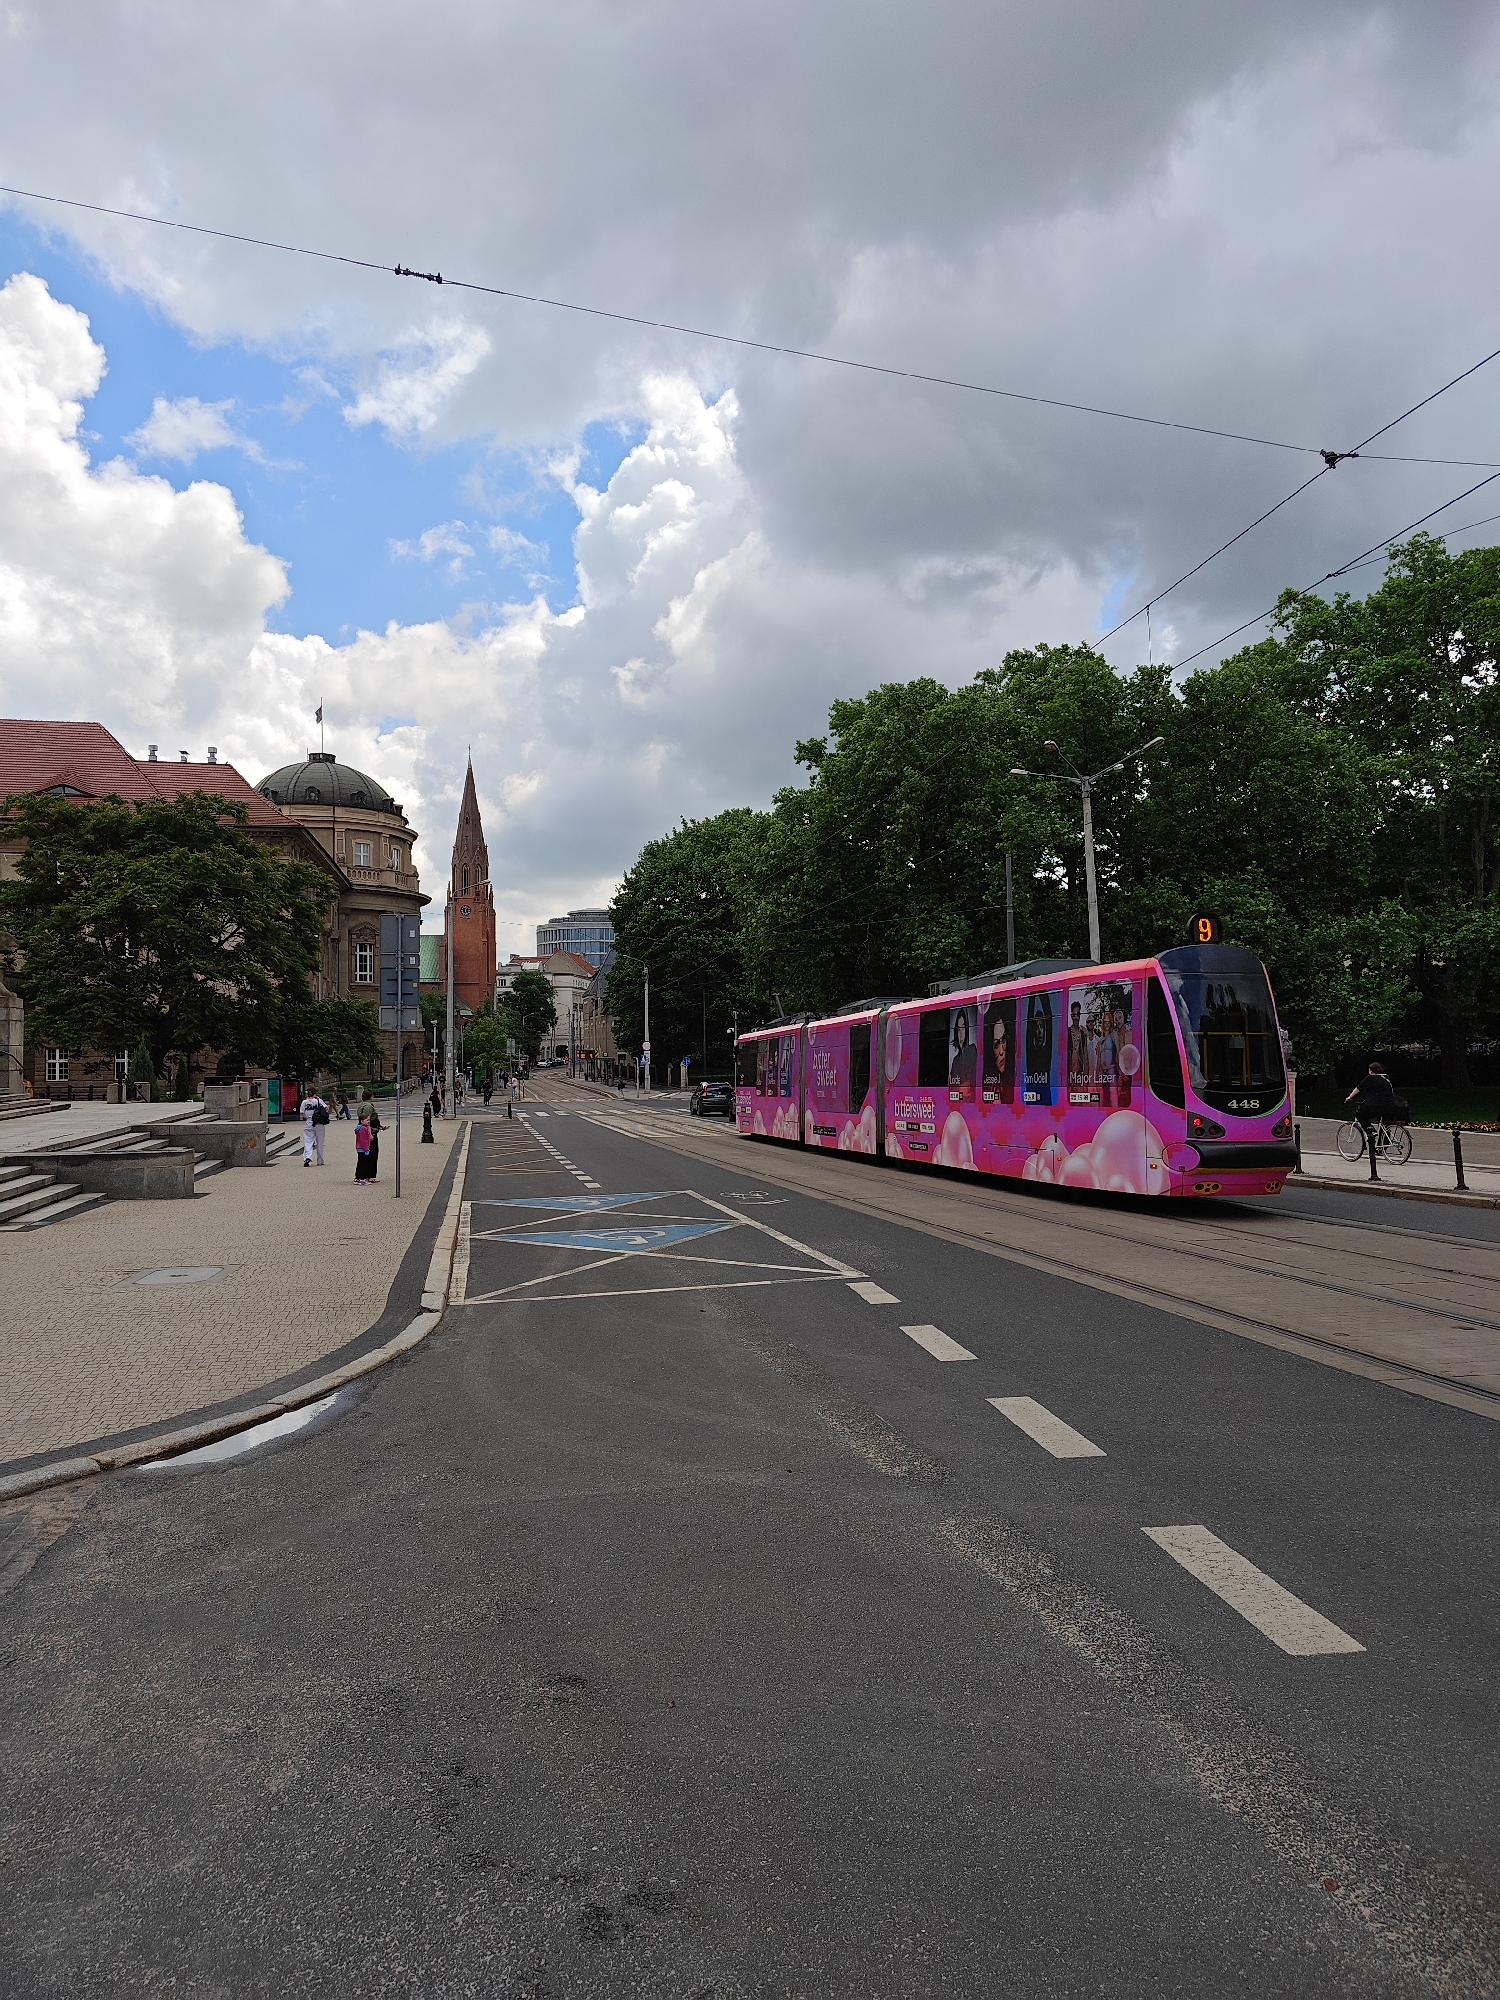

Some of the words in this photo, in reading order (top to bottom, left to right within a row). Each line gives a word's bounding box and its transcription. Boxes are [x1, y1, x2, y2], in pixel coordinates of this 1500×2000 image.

[1198, 918, 1212, 942] 9
[816, 1067, 837, 1087] sweet
[1022, 1072, 1033, 1084] Tom
[1033, 1071, 1048, 1084] Odell
[1069, 1071, 1092, 1086] Major
[1093, 1071, 1116, 1084] Lazer
[1227, 1099, 1260, 1109] 448
